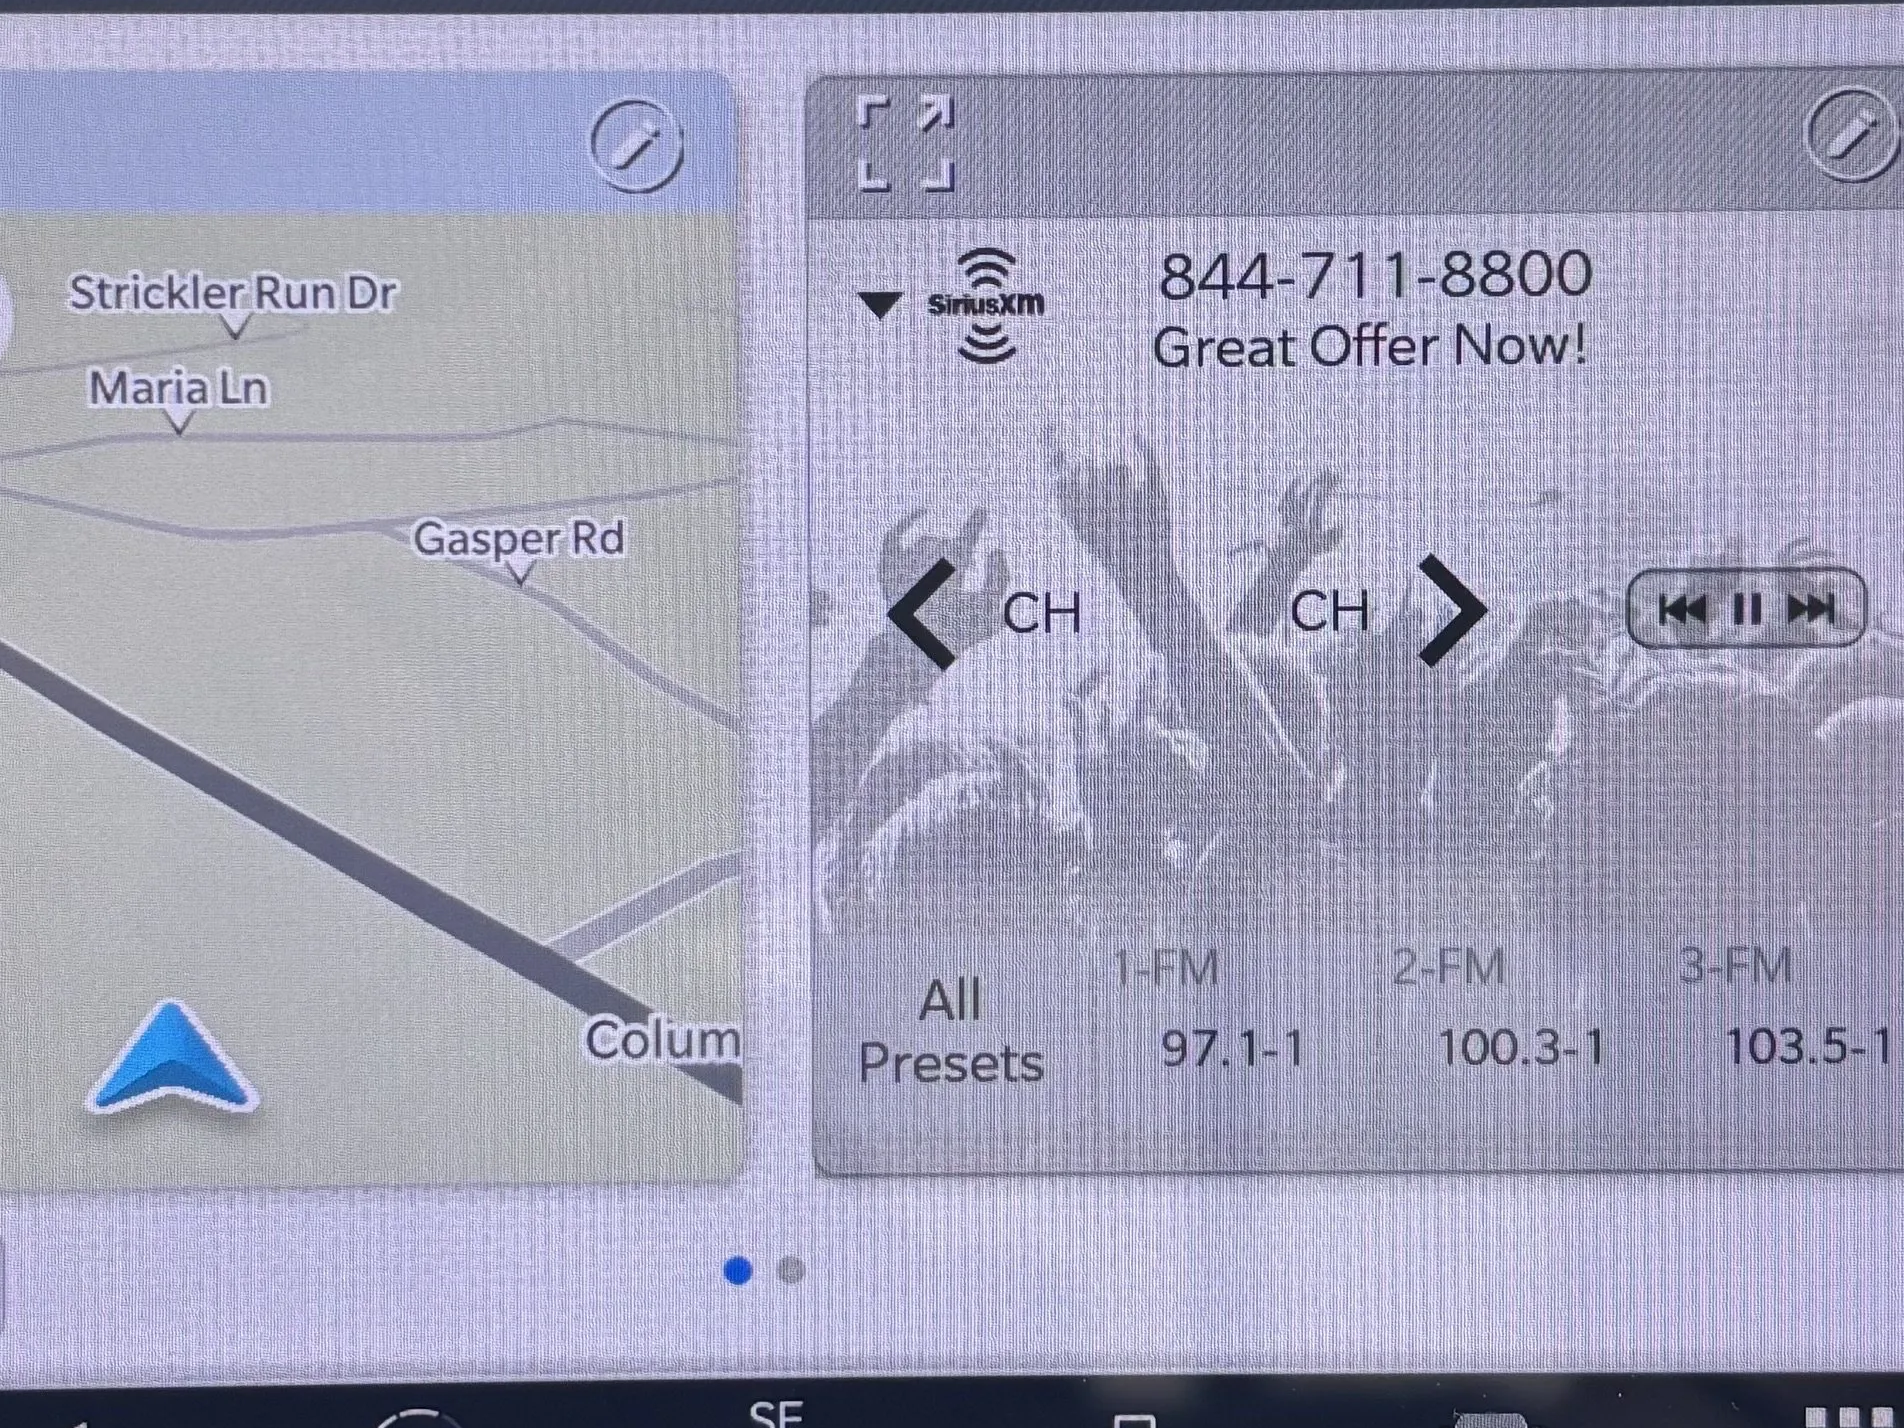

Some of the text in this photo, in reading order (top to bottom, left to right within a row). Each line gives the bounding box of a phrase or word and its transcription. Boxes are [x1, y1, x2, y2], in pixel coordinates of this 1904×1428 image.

[70, 272, 396, 311] Strickler Run Dr
[1160, 250, 1592, 300] 844-711-8800
[1155, 324, 1589, 368] Great Offer Now!
[89, 371, 268, 407] Maria Ln
[413, 518, 624, 562] Gasper Rd
[1003, 591, 1080, 635] CH
[1290, 589, 1368, 633] CH
[1115, 949, 1218, 988] 1-FM
[1392, 947, 1504, 986] 2-FM
[1681, 946, 1791, 985] 3-FM
[919, 978, 980, 1021] All
[586, 1017, 741, 1058] Colum
[1162, 1029, 1302, 1068] 97.1-1
[1439, 1029, 1602, 1067] 100.3-1
[1726, 1027, 1891, 1066] 103.5-1
[860, 1044, 1044, 1083] Presets
